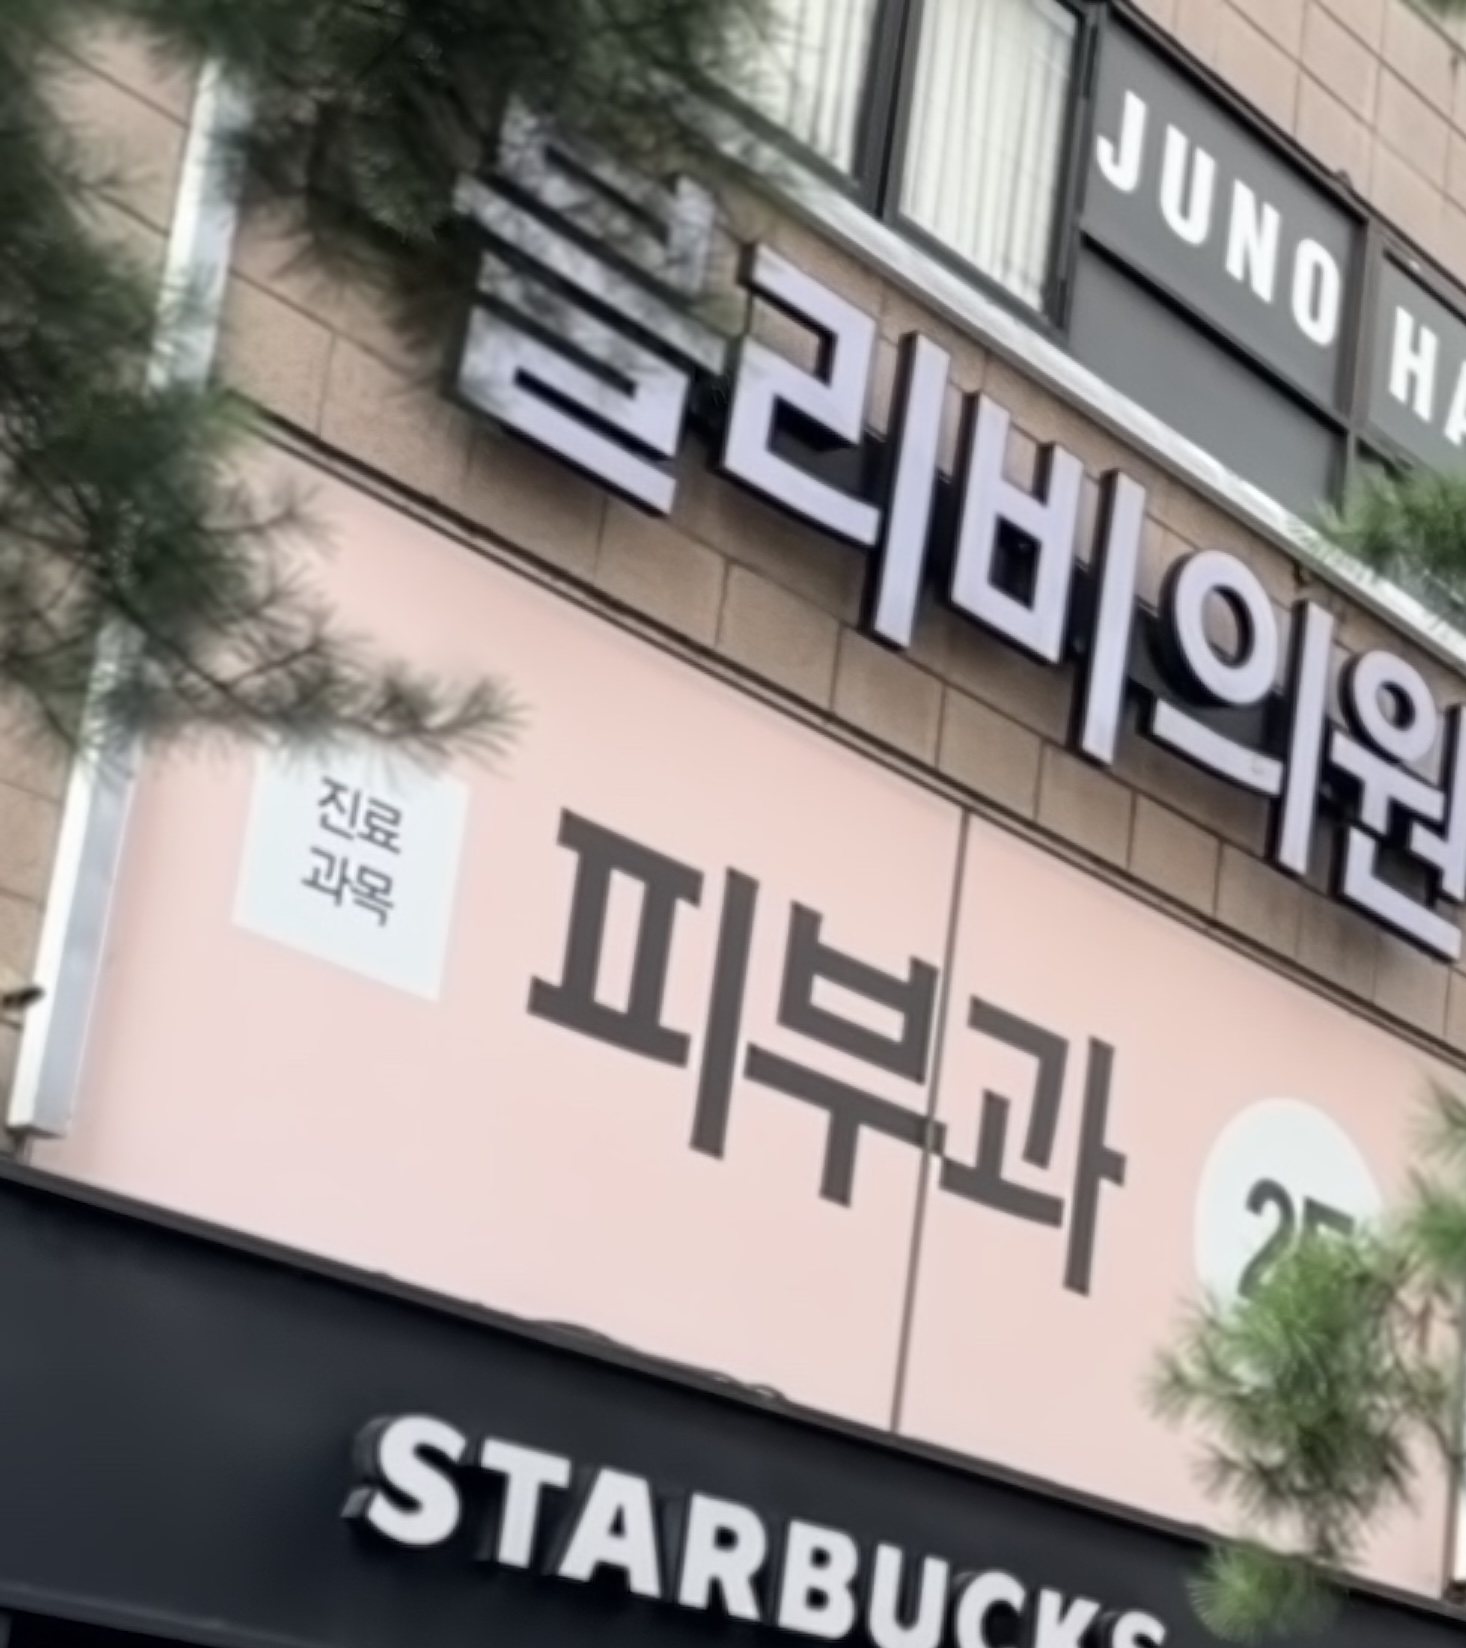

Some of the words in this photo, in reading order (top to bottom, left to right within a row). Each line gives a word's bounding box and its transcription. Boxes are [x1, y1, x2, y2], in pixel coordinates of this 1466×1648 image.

[1096, 88, 1342, 348] JUNO
[300, 845, 396, 926] 과목
[316, 774, 405, 856] 진료
[526, 806, 1127, 1297] 피부과
